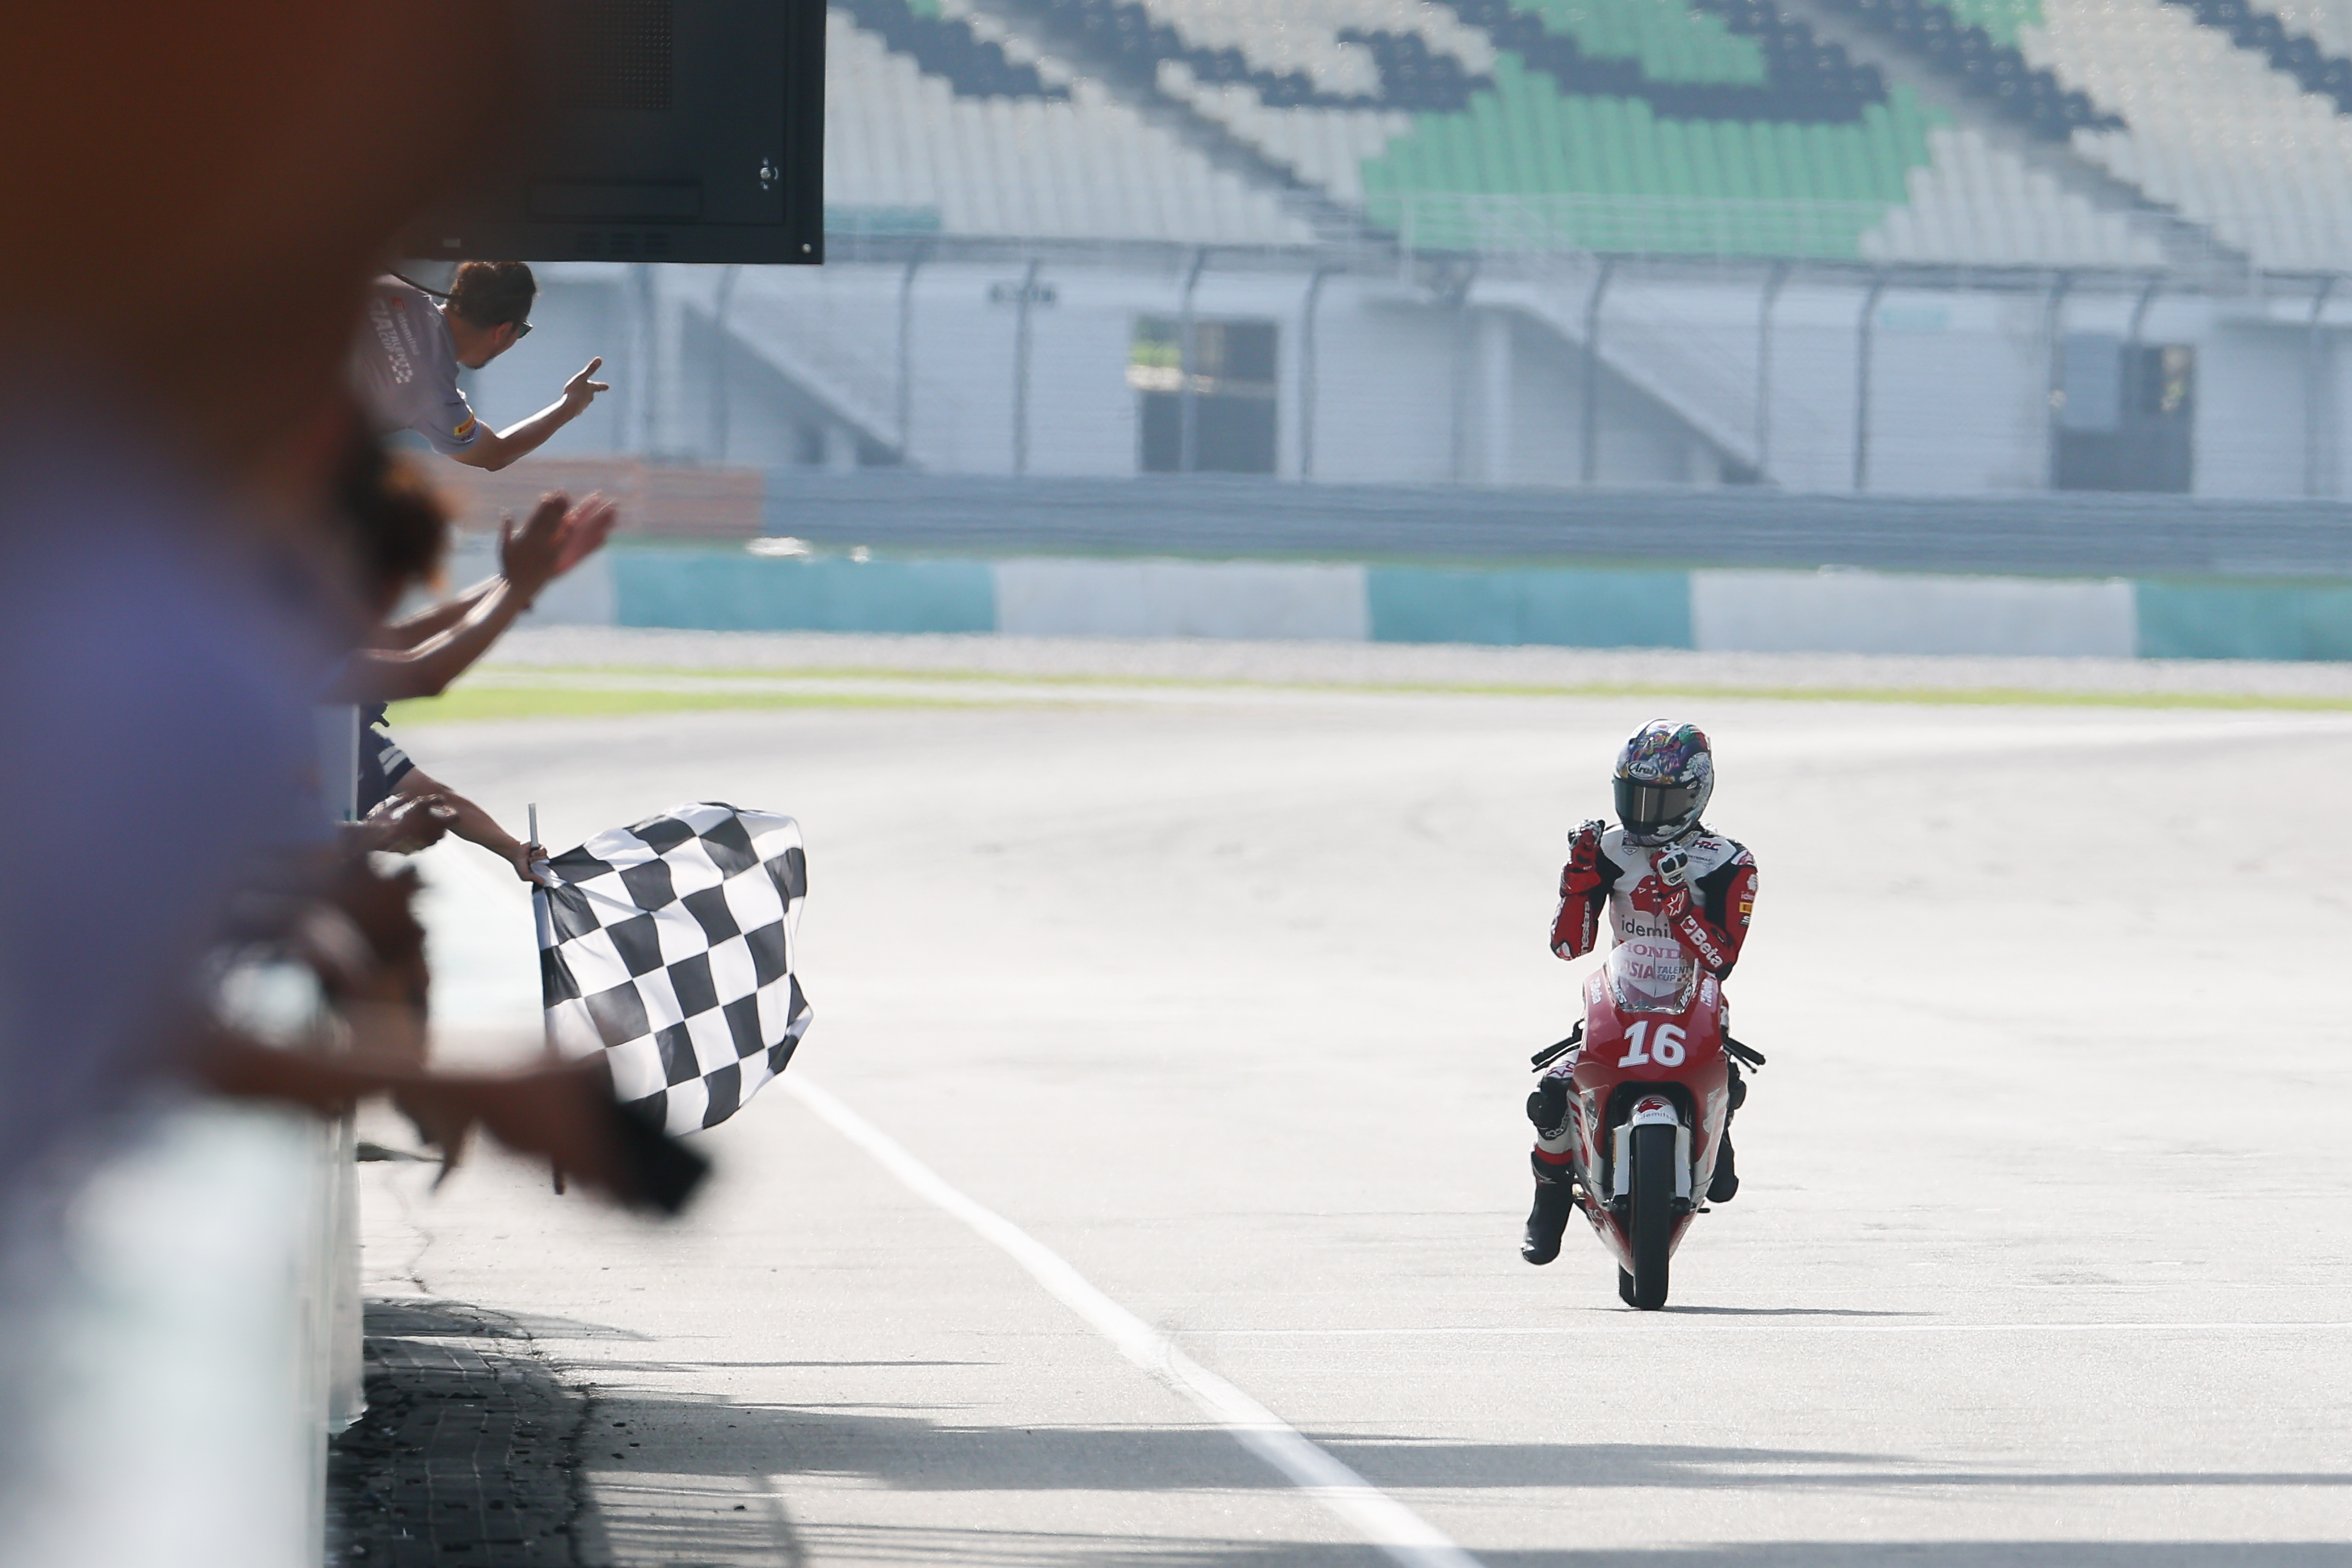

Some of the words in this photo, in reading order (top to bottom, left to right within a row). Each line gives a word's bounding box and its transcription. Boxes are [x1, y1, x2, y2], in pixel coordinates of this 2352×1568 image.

[1629, 762, 1655, 775] Arai
[1692, 839, 1722, 852] HRC
[1621, 914, 1674, 940] idemi
[1621, 942, 1681, 959] HOND
[1690, 928, 1723, 968] Beta
[1657, 965, 1689, 974] TALENT
[1618, 1021, 1686, 1068] 16
